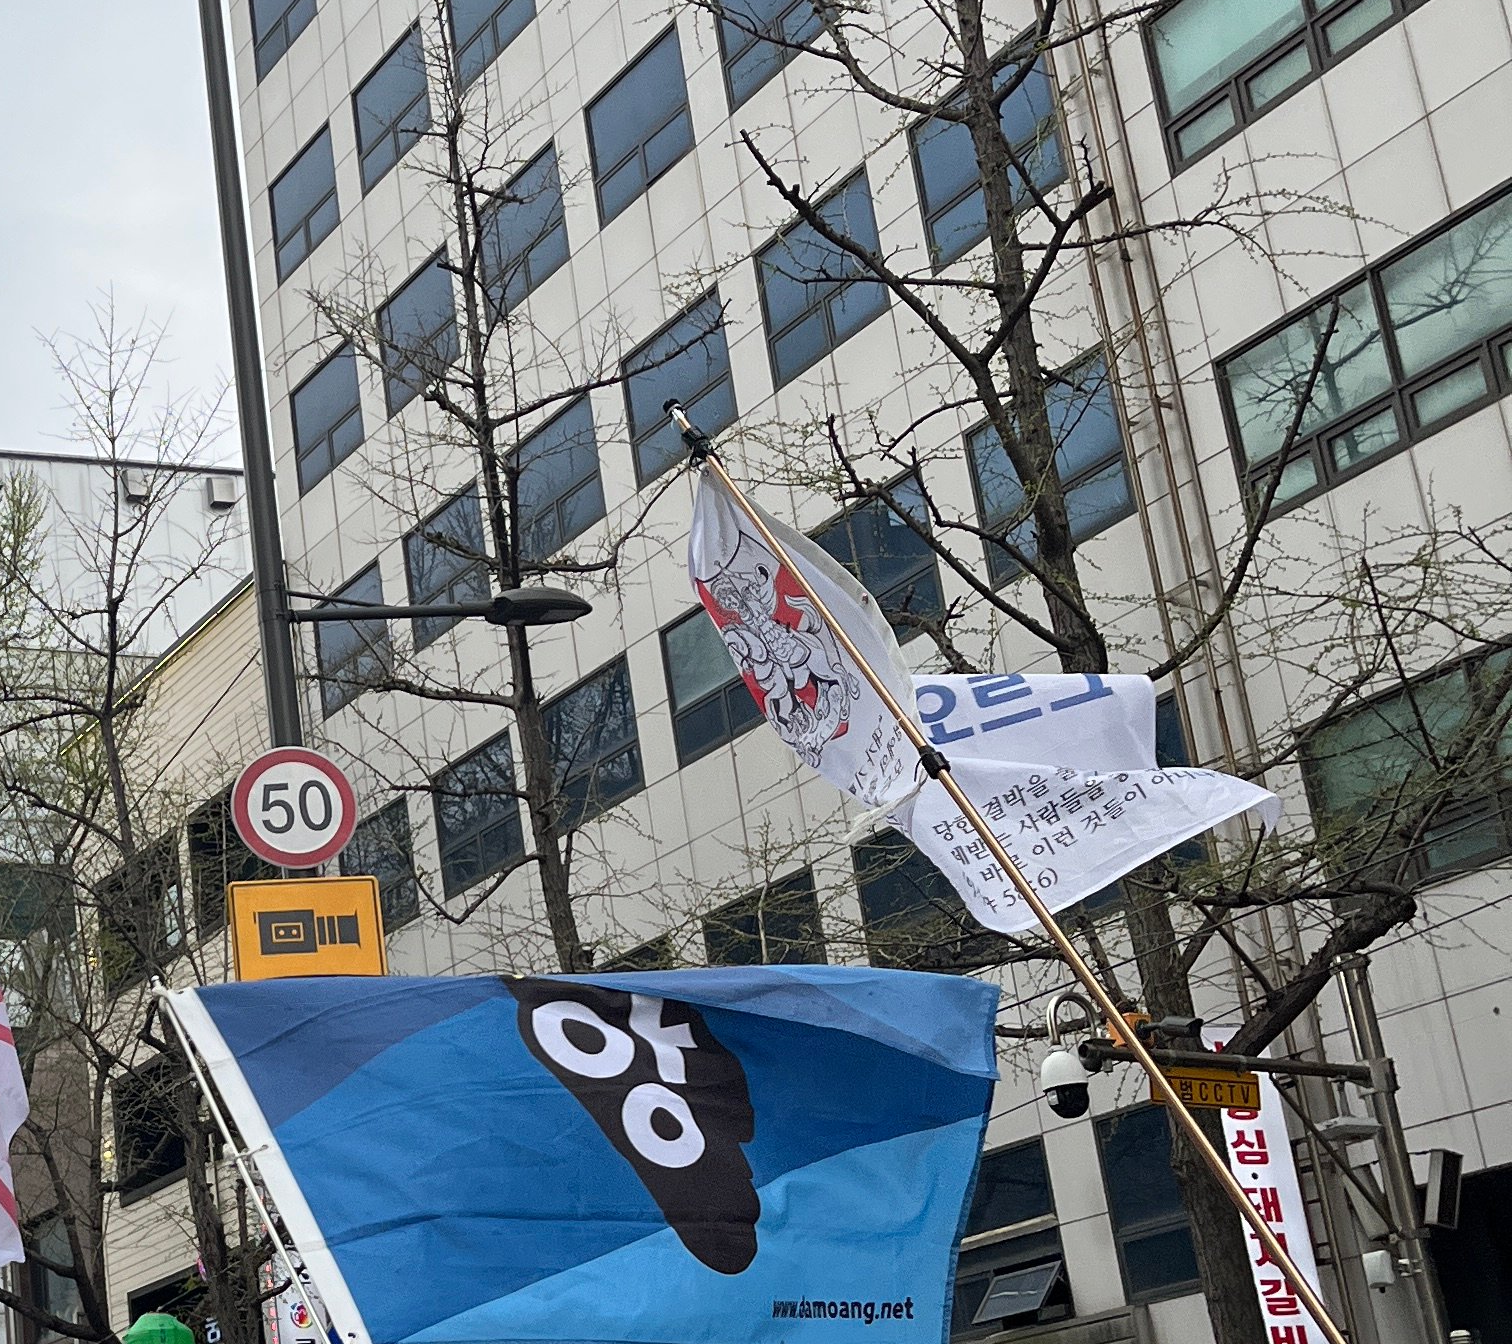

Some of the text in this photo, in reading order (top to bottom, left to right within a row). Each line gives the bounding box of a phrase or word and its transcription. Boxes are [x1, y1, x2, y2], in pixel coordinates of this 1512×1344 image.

[260, 780, 333, 833] 50
[980, 773, 1049, 822] 결박을
[1018, 778, 1105, 836] 사람들을
[1032, 825, 1080, 857] 이런
[1082, 783, 1148, 834] 것들이
[1169, 1079, 1249, 1104] 범CCTV
[772, 1296, 914, 1324] www.damoang.net
